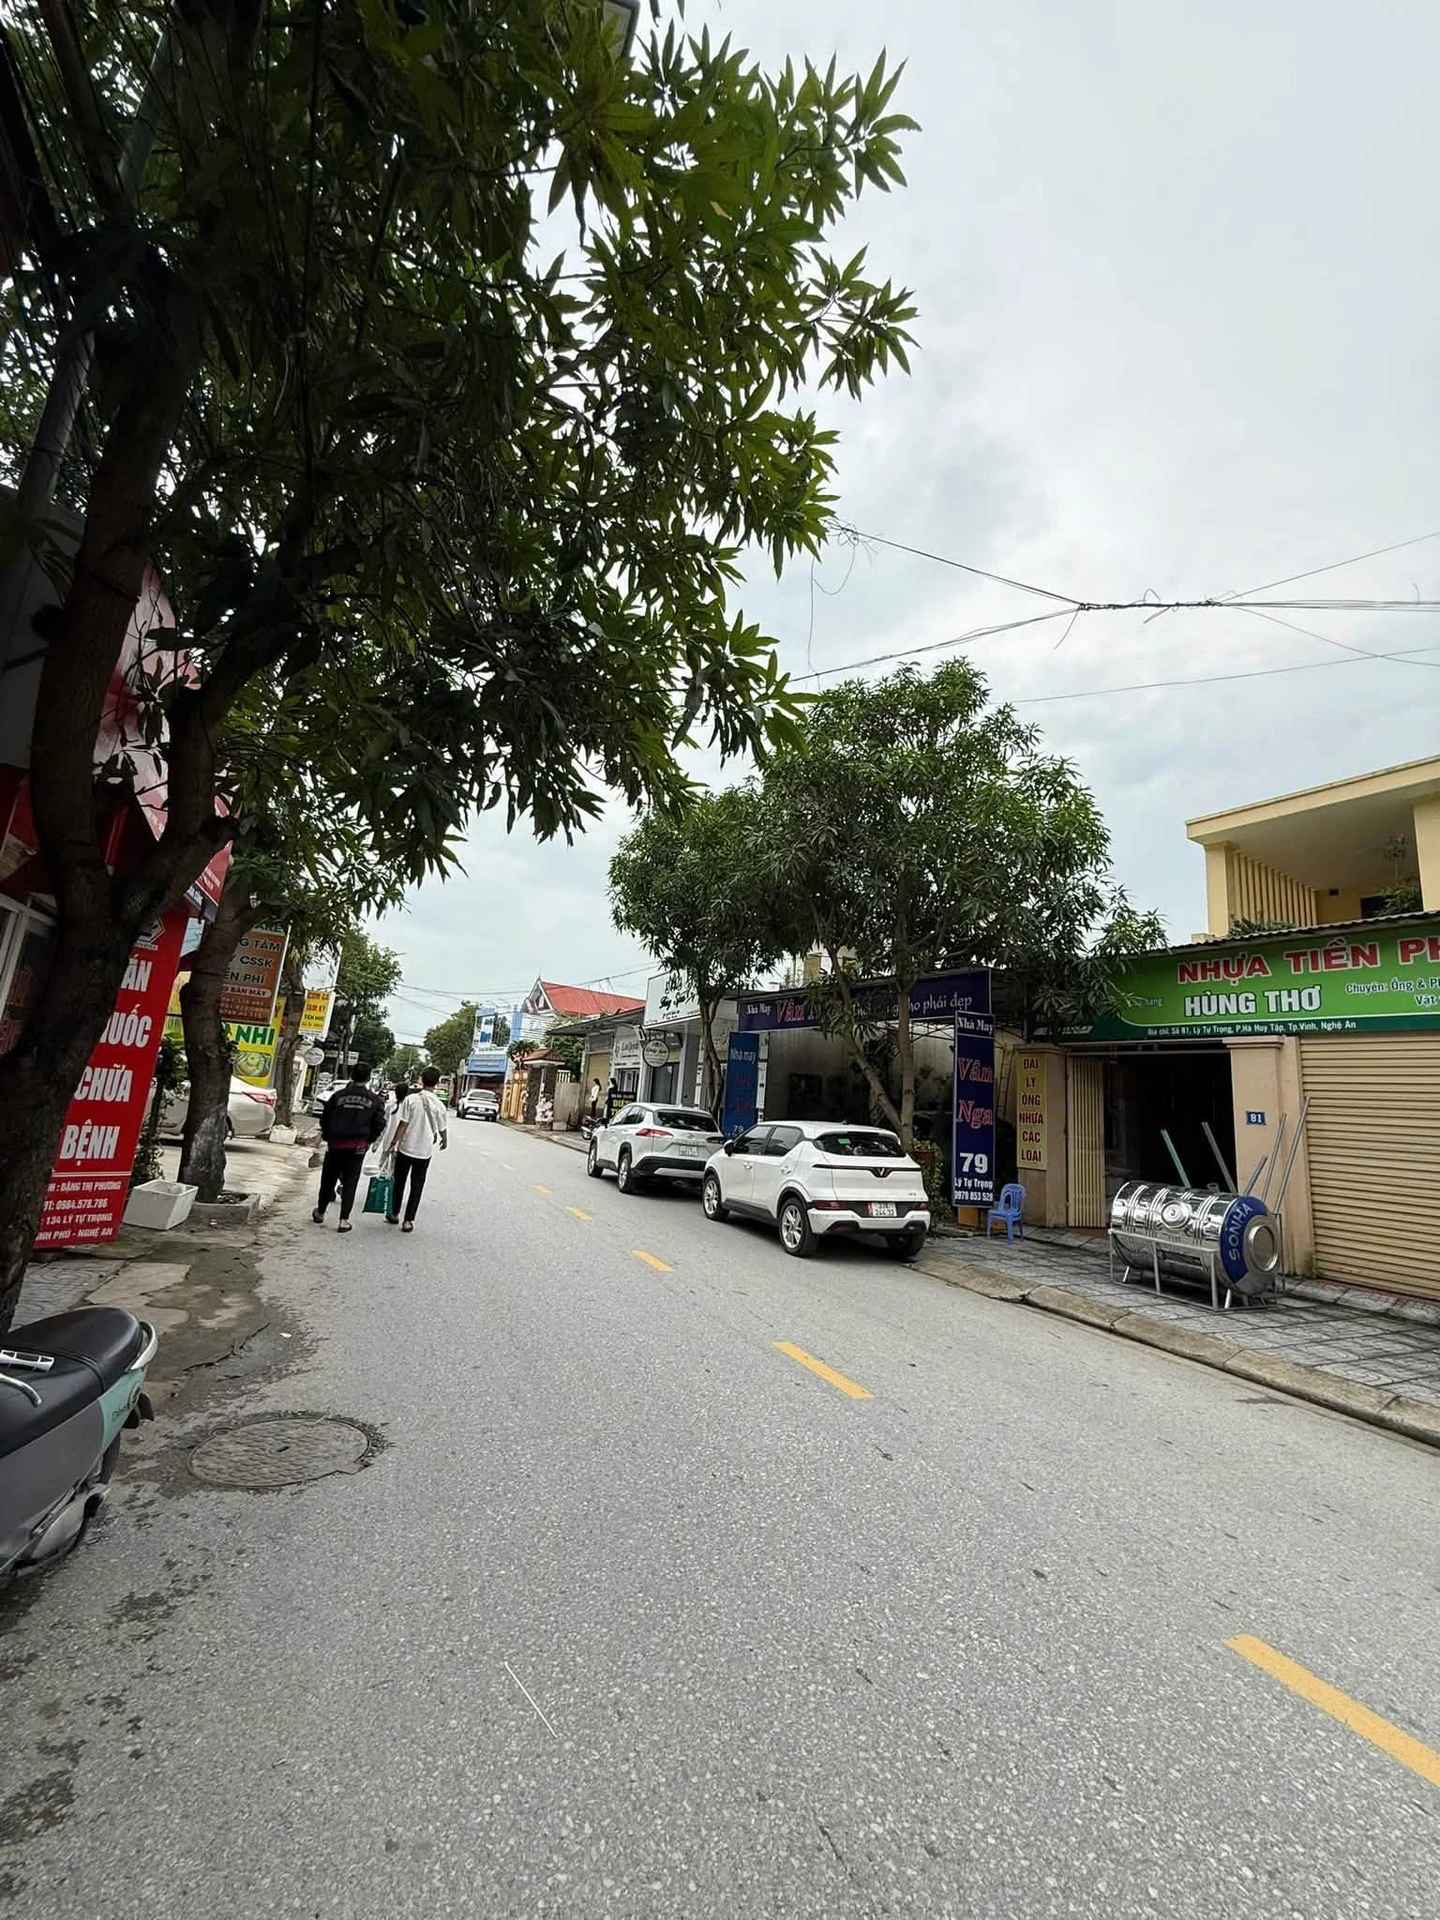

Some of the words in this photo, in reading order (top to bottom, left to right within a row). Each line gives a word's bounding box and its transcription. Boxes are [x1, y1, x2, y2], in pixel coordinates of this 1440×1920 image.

[240, 955, 273, 968] CSSK
[1178, 951, 1272, 986] NHỰA
[1283, 936, 1381, 975] TIỀN
[908, 997, 920, 1012] ho
[923, 993, 947, 1015] phái
[950, 991, 973, 1011] đẹp
[1185, 990, 1257, 1017] HÙNG
[1264, 984, 1322, 1012] THƠ
[235, 1025, 276, 1046] NHI
[957, 1016, 975, 1030] Nhà
[976, 1019, 993, 1036] May
[1254, 1024, 1268, 1034] Huy
[1320, 1021, 1343, 1031] Nghệ
[1344, 1020, 1357, 1029] An
[957, 1056, 993, 1084] Vân
[956, 1100, 993, 1130] Nga
[1249, 1113, 1263, 1123] 81
[60, 1119, 121, 1166] BỆNH
[959, 1152, 988, 1174] 79
[954, 1177, 963, 1188] Lý
[963, 1177, 972, 1189] Tự
[973, 1178, 993, 1191] Trọng
[101, 1227, 114, 1236] AN
[1228, 1202, 1253, 1262] SONHA
